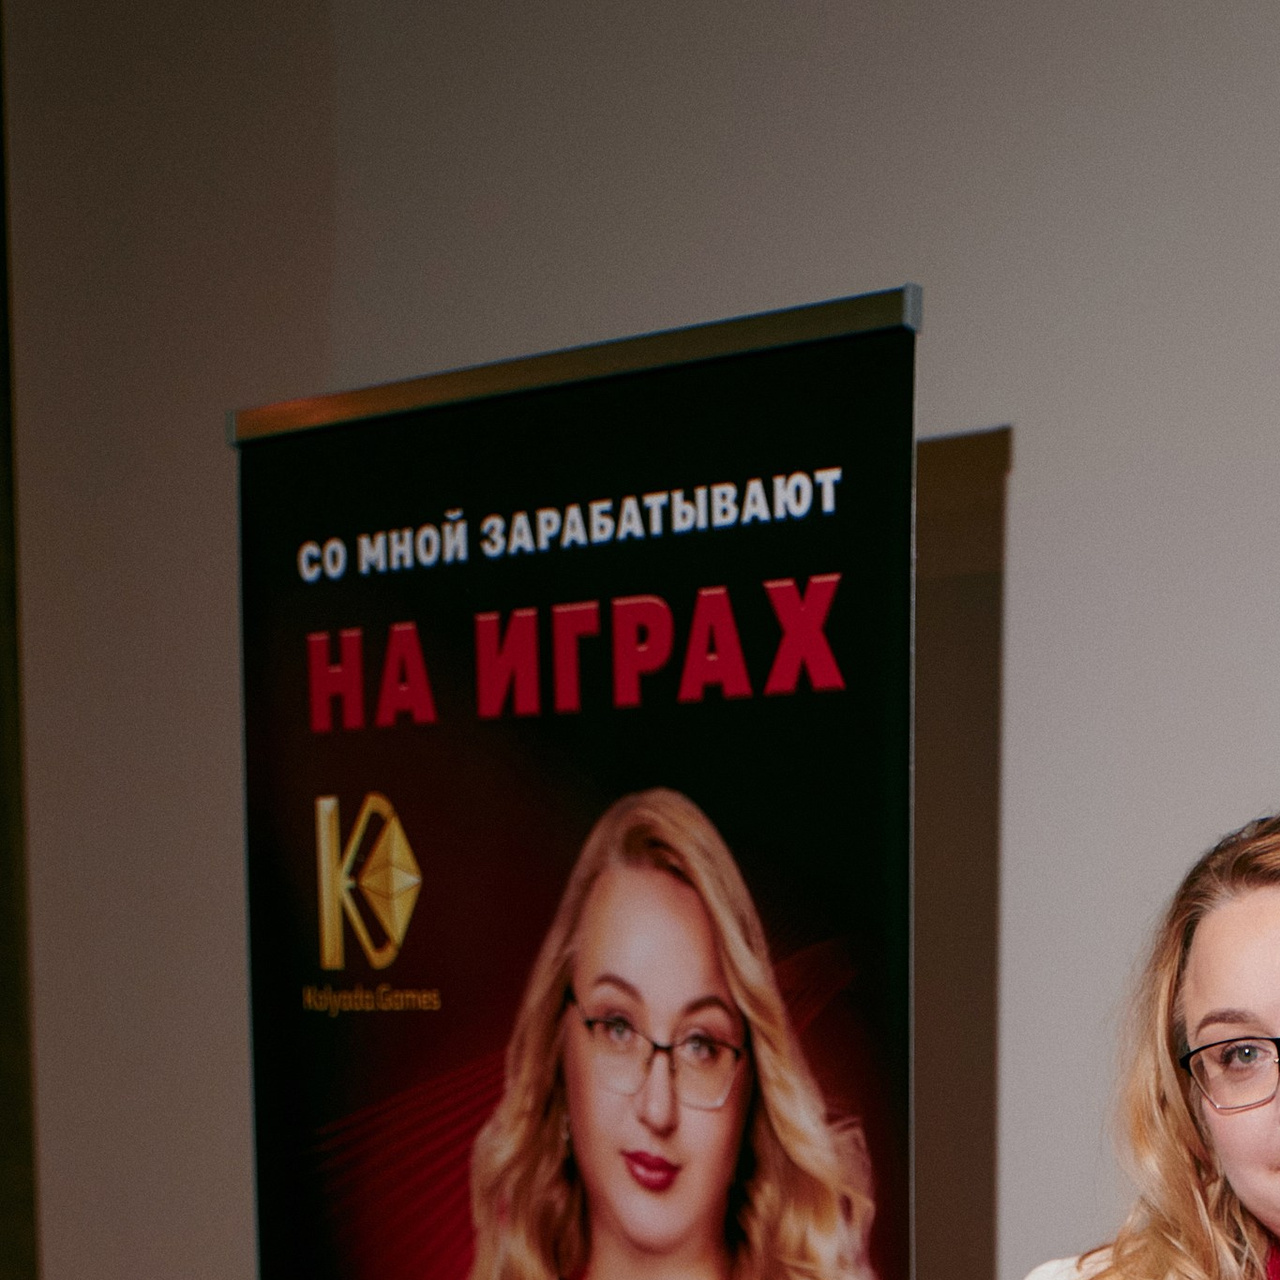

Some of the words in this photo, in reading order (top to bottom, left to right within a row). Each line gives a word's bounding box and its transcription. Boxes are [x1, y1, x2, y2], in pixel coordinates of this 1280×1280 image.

[299, 538, 348, 583] СО
[357, 509, 469, 577] МНОЙ
[480, 466, 843, 560] ЗАРАБАТЫВАЮТ
[306, 621, 438, 734] НА
[474, 572, 847, 720] ИГРАХ
